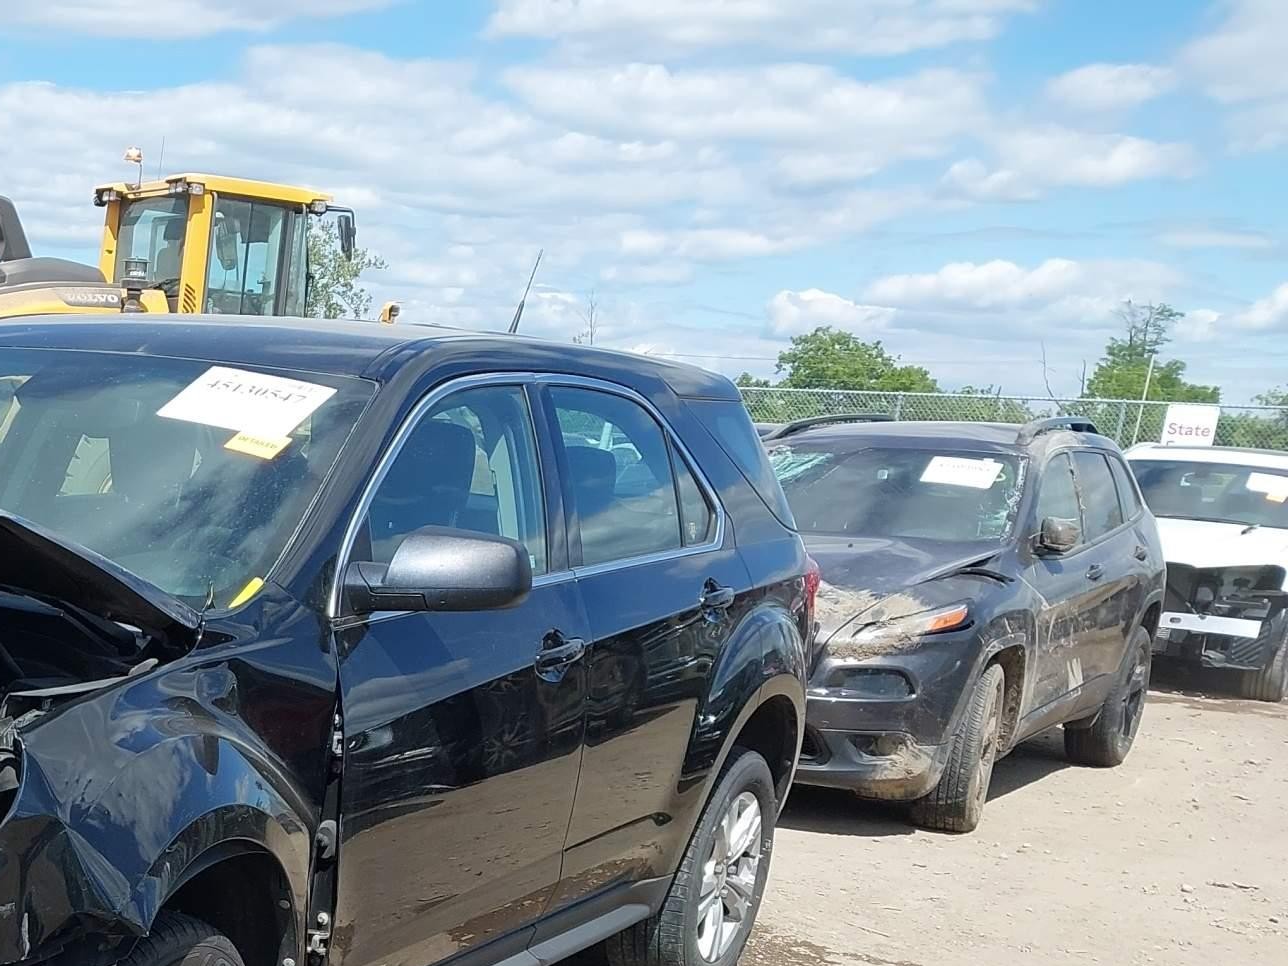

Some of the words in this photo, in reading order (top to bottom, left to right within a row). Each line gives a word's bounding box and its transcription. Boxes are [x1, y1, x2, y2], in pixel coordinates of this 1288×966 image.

[66, 293, 119, 303] VOLVO
[207, 380, 307, 404] 45130547
[1167, 422, 1211, 437] State
